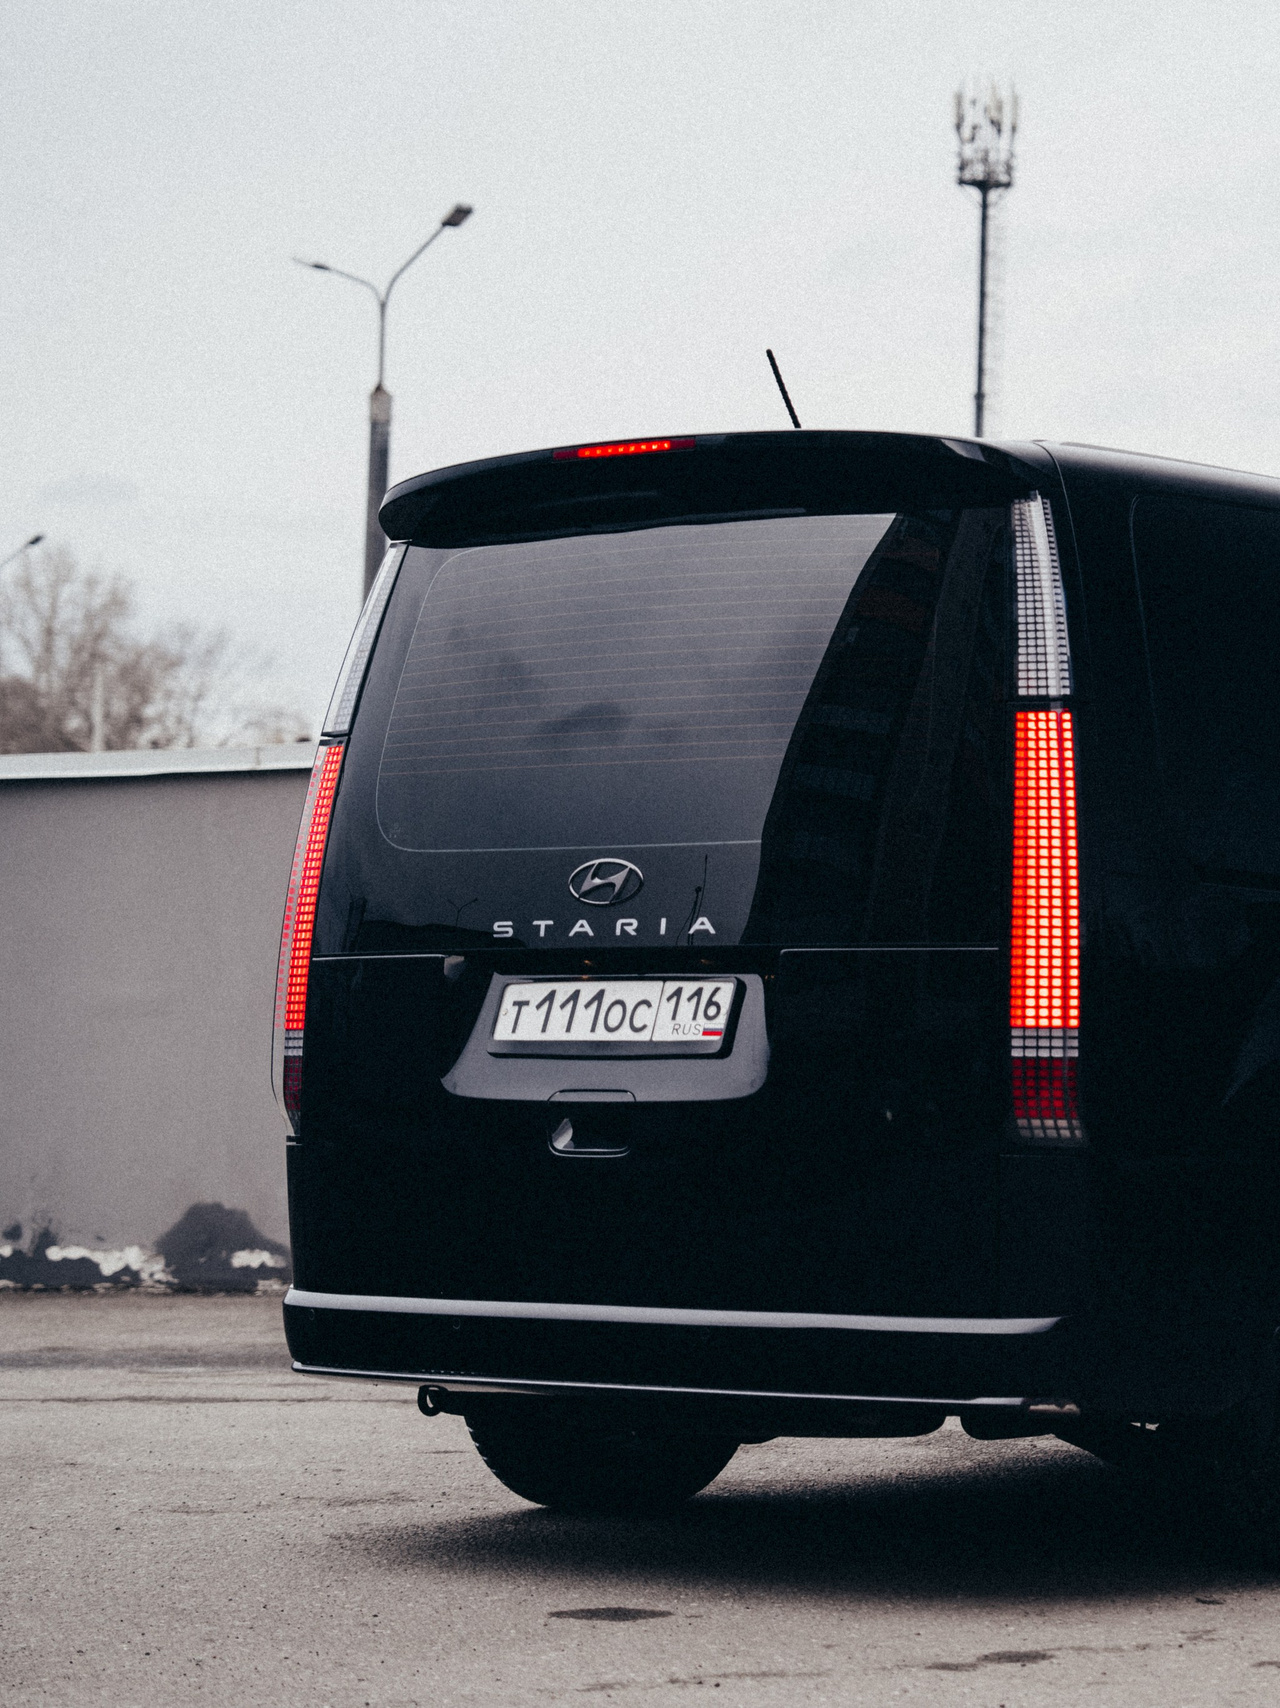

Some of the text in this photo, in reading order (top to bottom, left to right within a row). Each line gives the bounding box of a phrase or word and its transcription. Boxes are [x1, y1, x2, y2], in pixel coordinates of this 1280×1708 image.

[493, 916, 716, 938] STARIA
[666, 986, 722, 1022] 116
[671, 1023, 701, 1036] RUS
